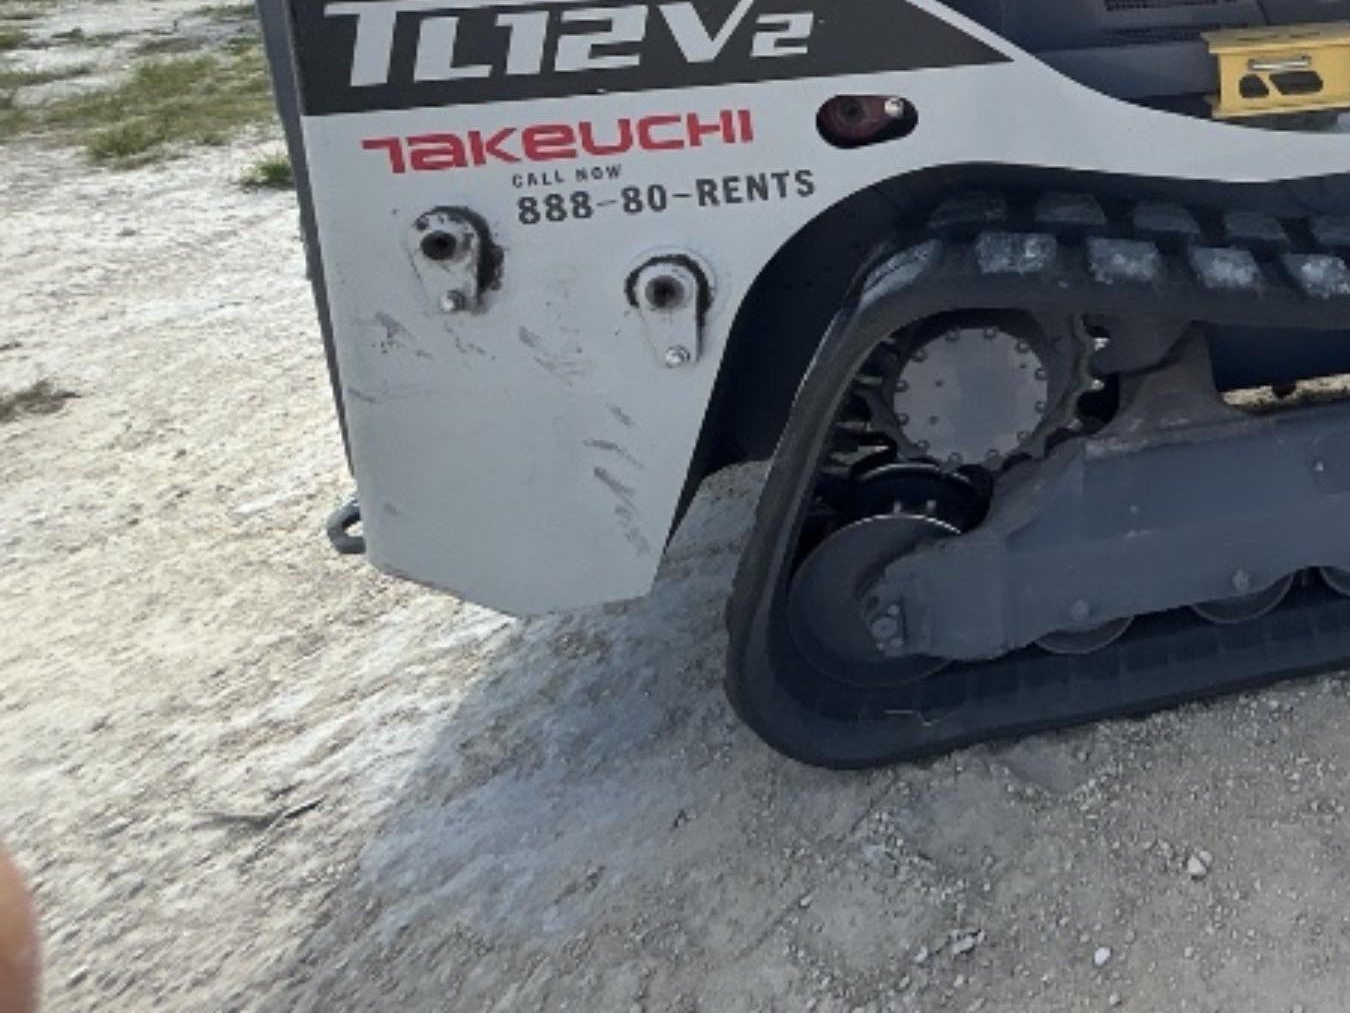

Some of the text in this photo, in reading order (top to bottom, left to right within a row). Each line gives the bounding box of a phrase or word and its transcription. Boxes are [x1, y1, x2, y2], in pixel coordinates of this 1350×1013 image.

[511, 163, 622, 189] CALL NOW
[517, 169, 817, 225] 888-80-RENTS
